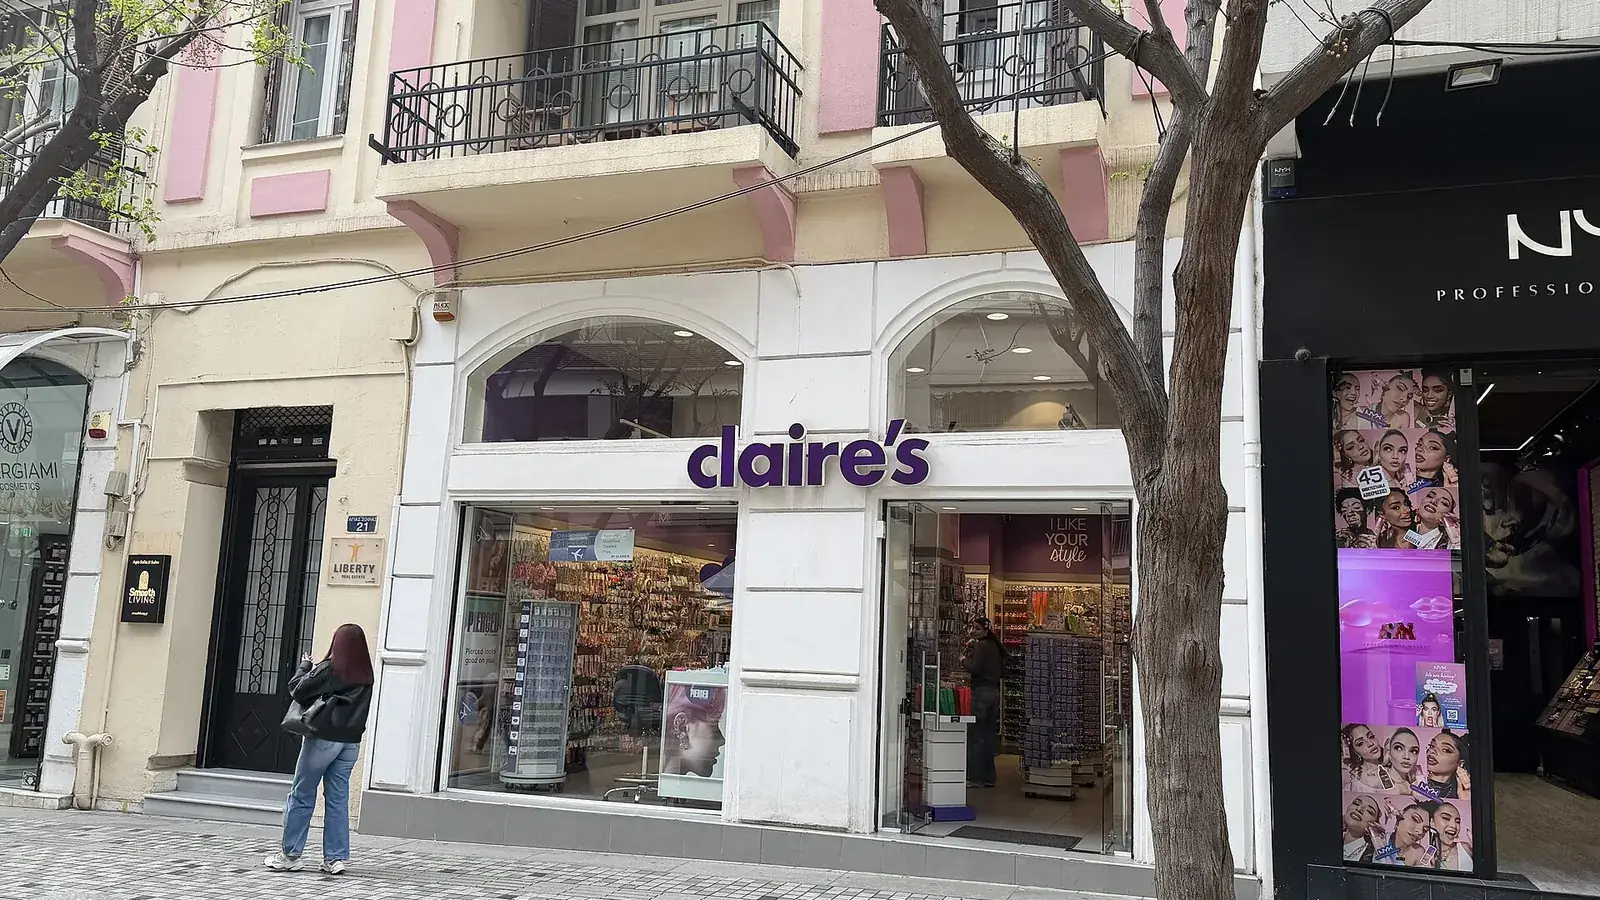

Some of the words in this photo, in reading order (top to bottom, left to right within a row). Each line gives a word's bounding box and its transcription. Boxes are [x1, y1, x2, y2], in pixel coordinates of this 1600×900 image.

[1436, 281, 1594, 301] PROFESSIO
[687, 418, 931, 489] claire's
[0, 462, 58, 479] RGIAMI
[1358, 467, 1383, 484] 45
[356, 522, 369, 532] 21
[1050, 517, 1054, 530] I
[1057, 517, 1087, 530] LIKE
[1044, 532, 1088, 546] YOUR
[1050, 545, 1087, 569] style
[334, 564, 375, 573] LIBERTY
[129, 587, 155, 597] Smooth
[1419, 783, 1438, 796] NYX
